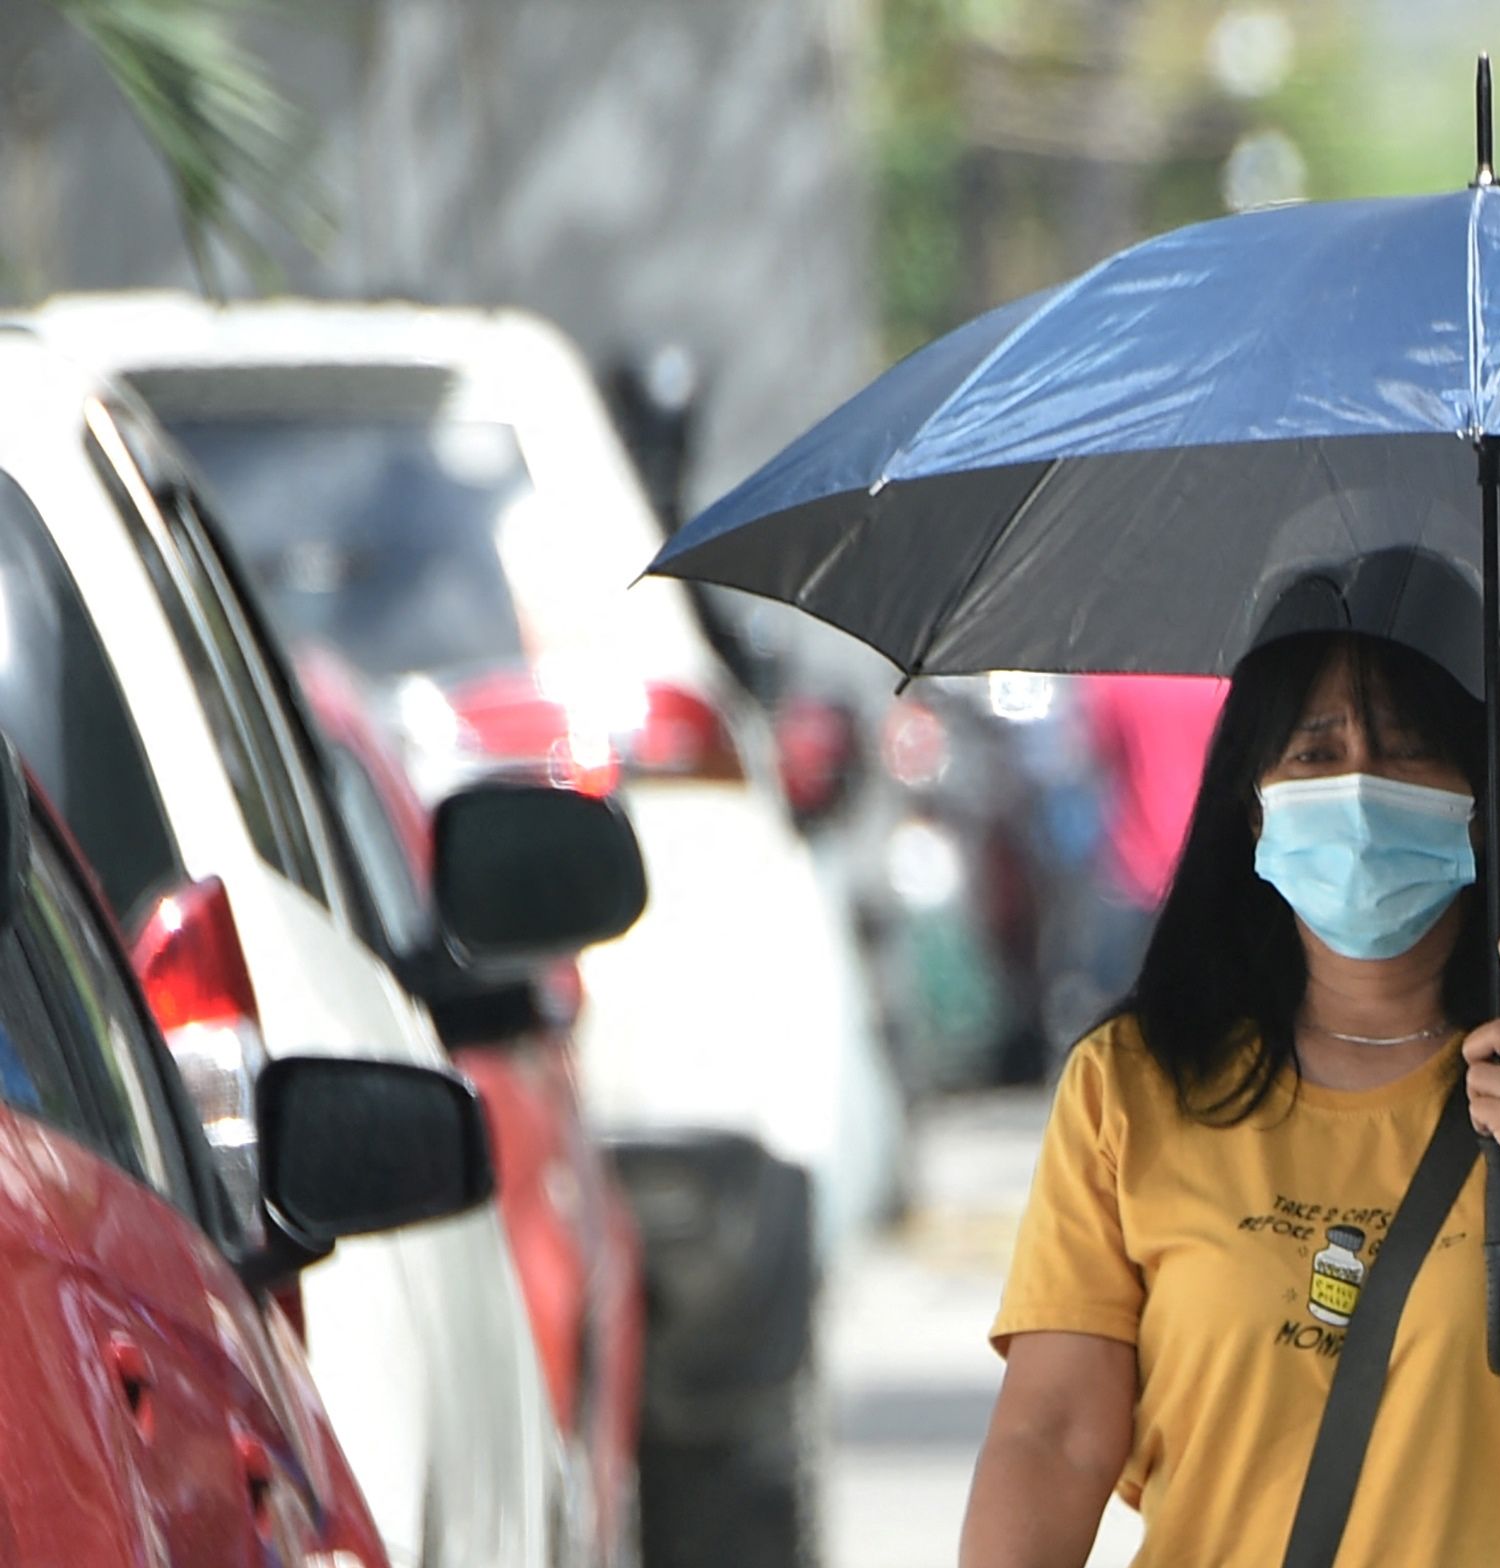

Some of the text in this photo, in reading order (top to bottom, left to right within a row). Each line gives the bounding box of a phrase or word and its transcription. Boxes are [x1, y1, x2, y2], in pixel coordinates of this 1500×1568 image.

[1273, 1195, 1321, 1221] TAKE
[1342, 1208, 1392, 1230] CAPS
[1237, 1215, 1315, 1241] BEFORE
